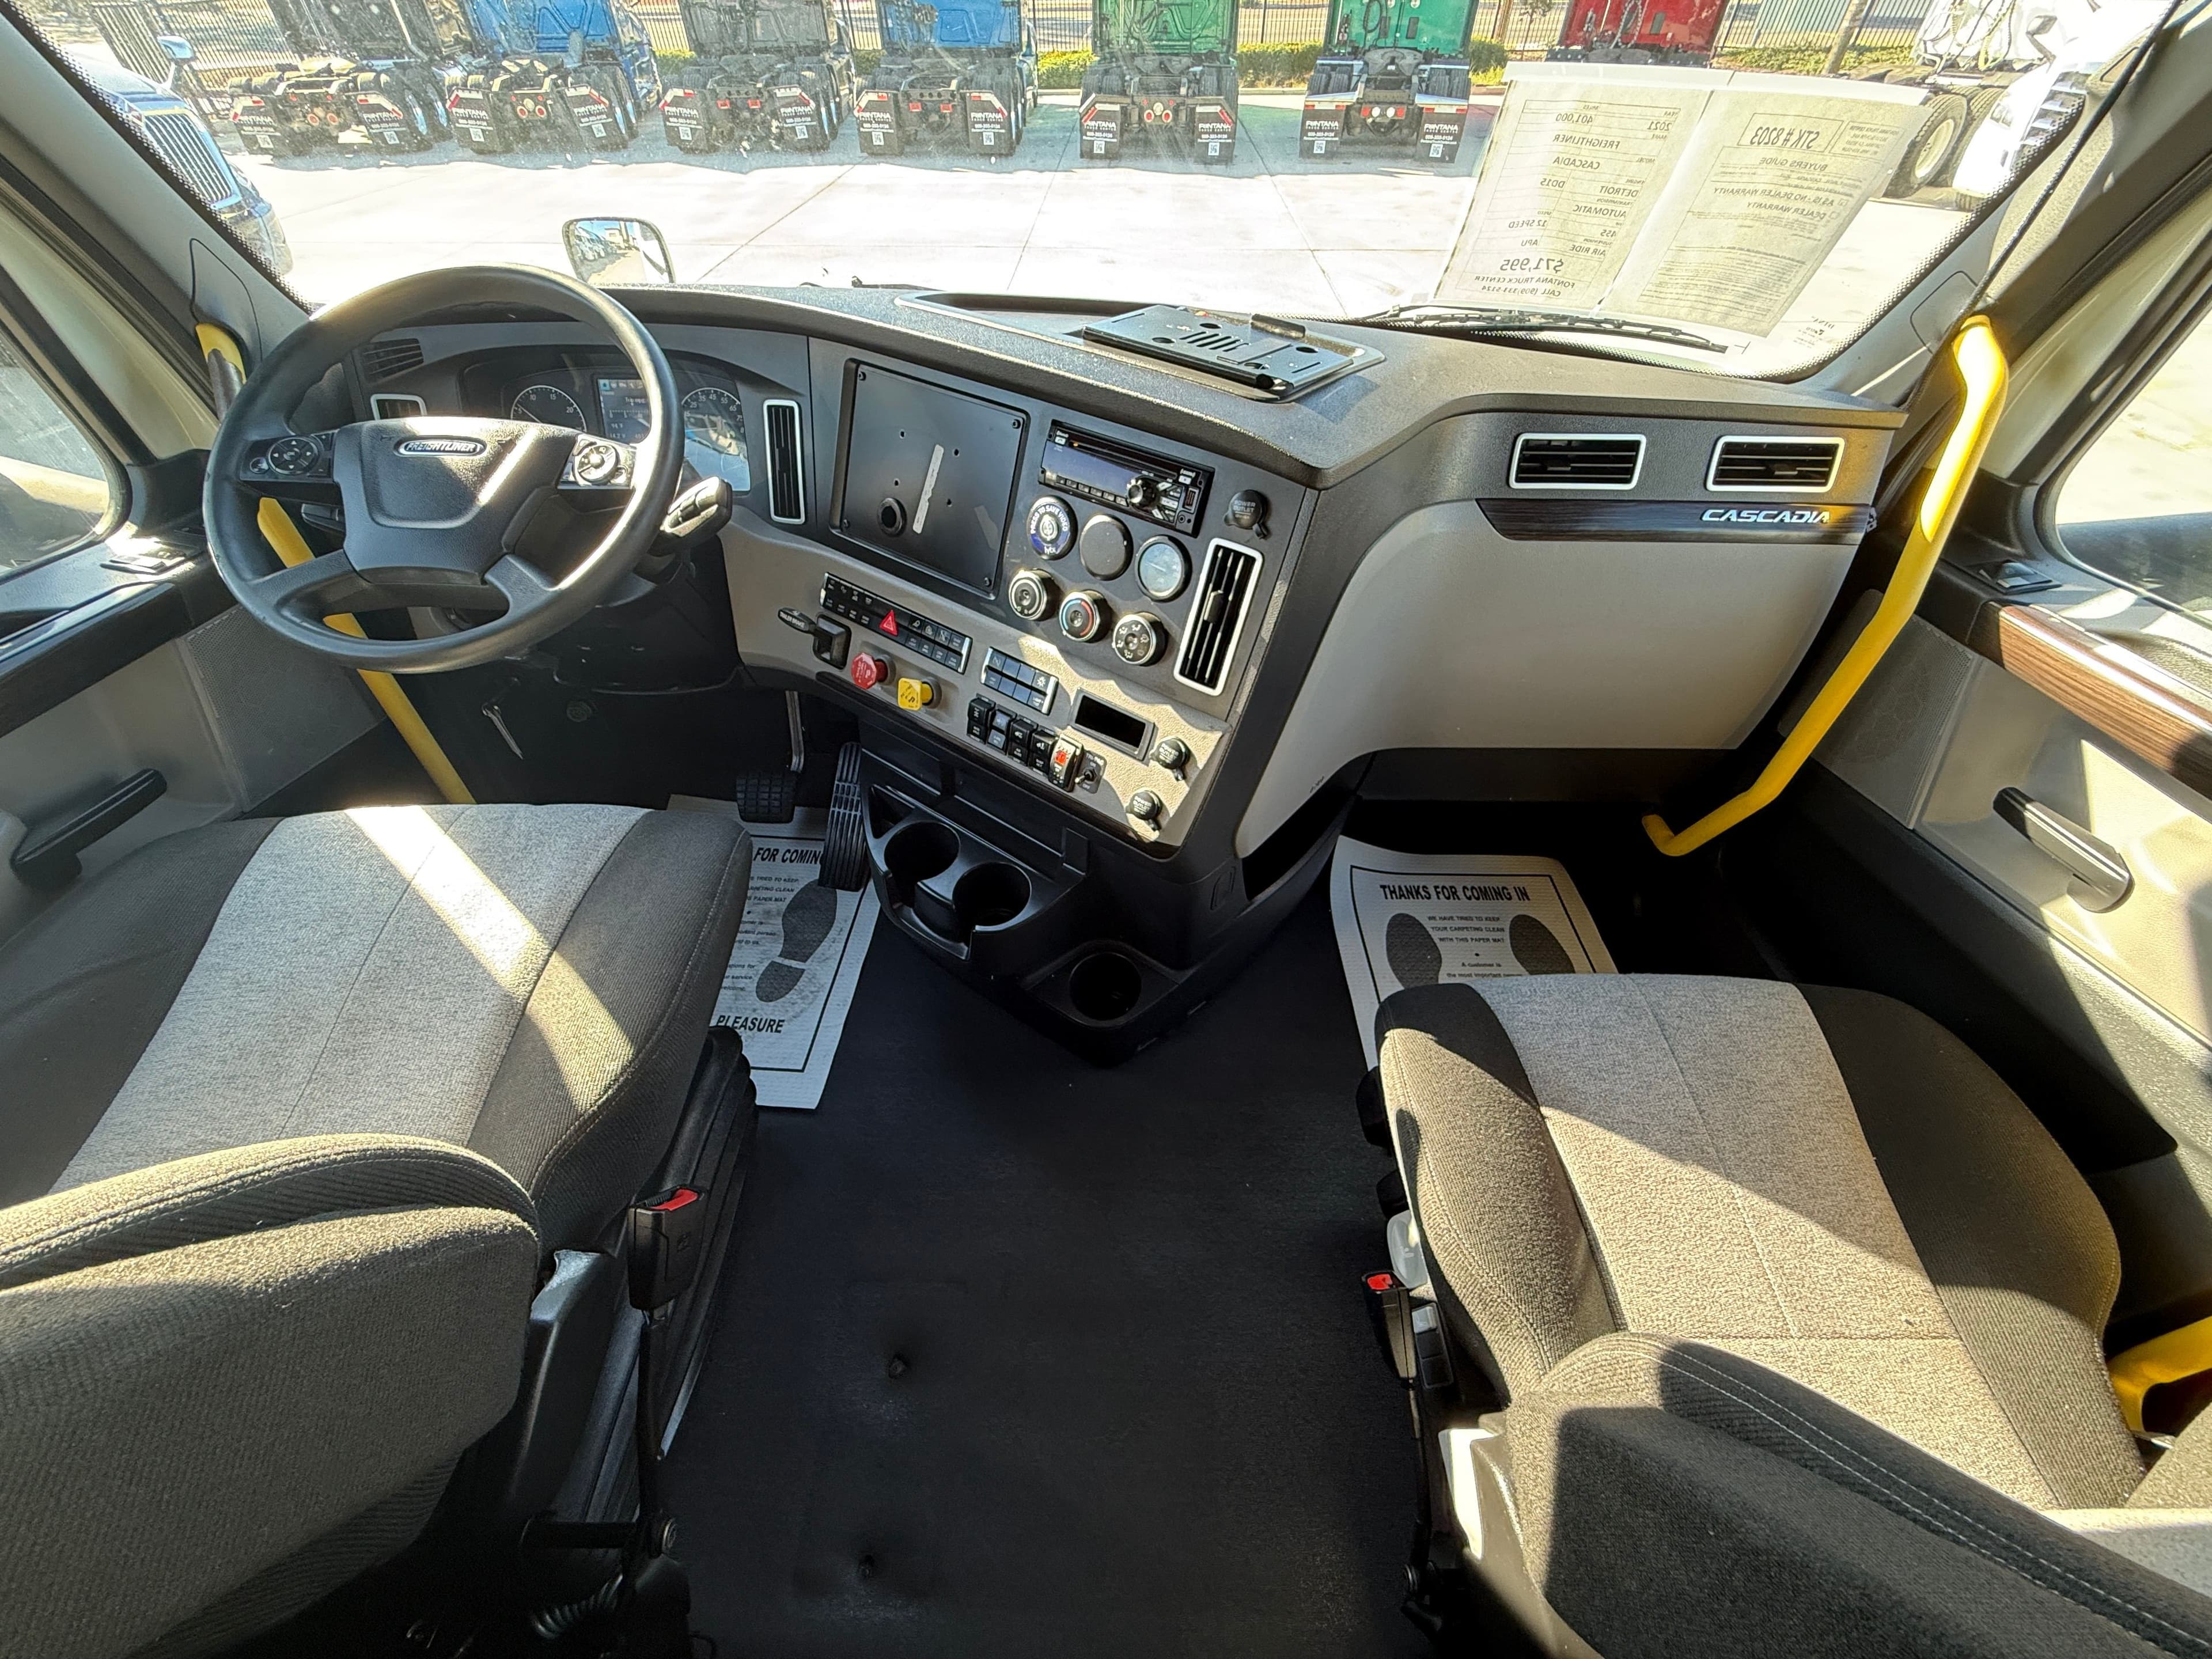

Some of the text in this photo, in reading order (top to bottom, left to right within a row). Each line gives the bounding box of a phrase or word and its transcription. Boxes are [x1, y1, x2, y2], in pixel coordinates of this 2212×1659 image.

[406, 442, 476, 452] FREIGHTLINER
[1030, 505, 1068, 535] PRESS TO SAVE VIDEO
[1702, 509, 1831, 523] CASCADIA
[753, 847, 823, 865] FOR COMIN
[1380, 884, 1531, 902] THANKS FOR COMING IN
[716, 1014, 785, 1034] PLEASURE
